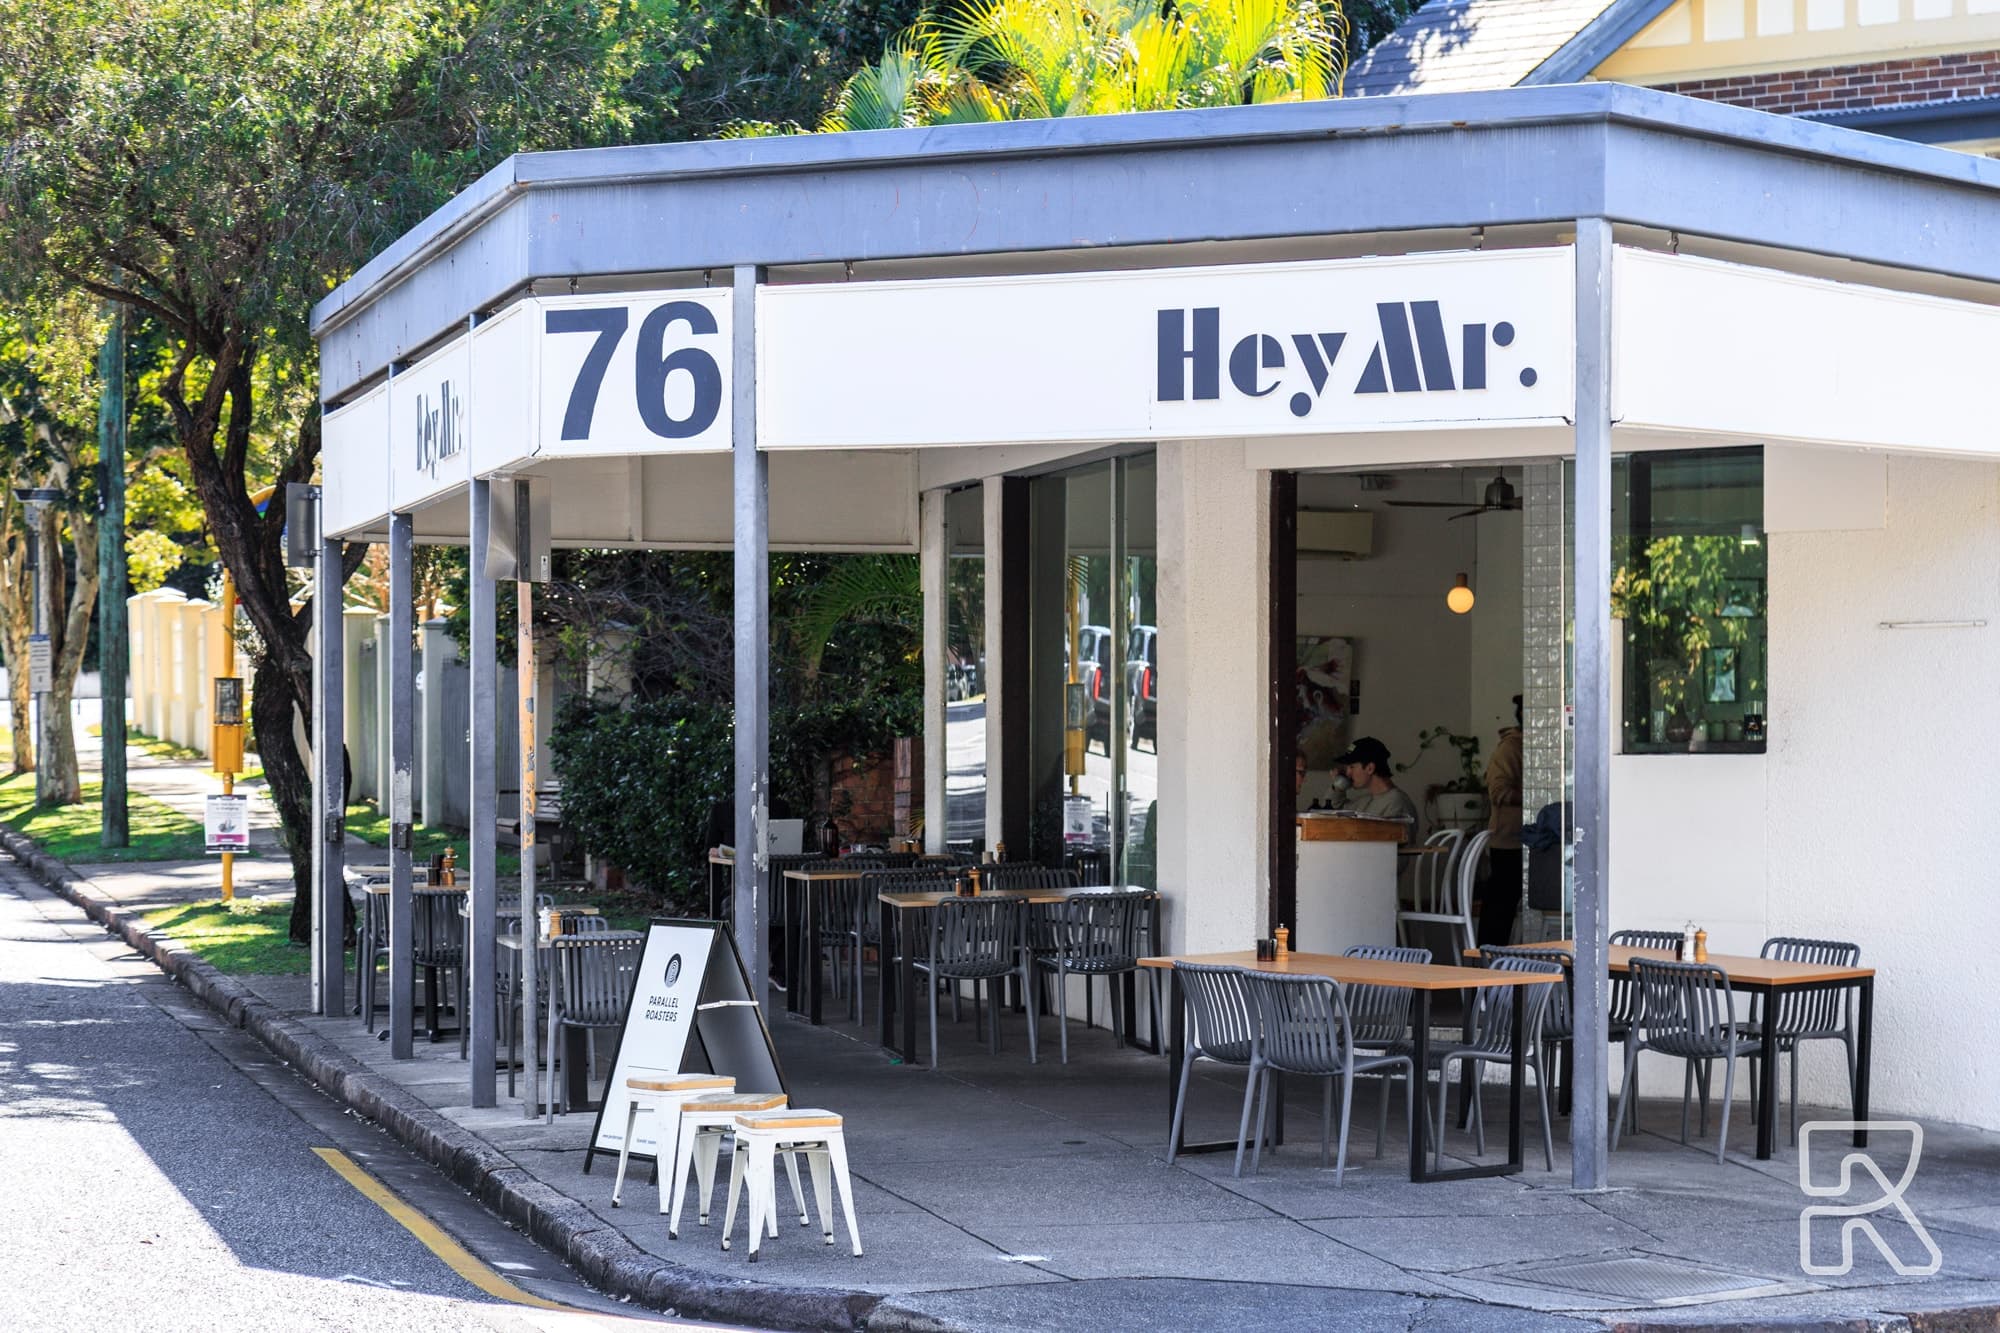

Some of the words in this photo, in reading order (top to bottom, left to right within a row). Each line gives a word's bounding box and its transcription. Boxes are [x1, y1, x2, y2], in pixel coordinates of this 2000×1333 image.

[546, 300, 722, 440] 76
[649, 995, 679, 1008] PARALLEL
[645, 1009, 678, 1022] ROASTERS
